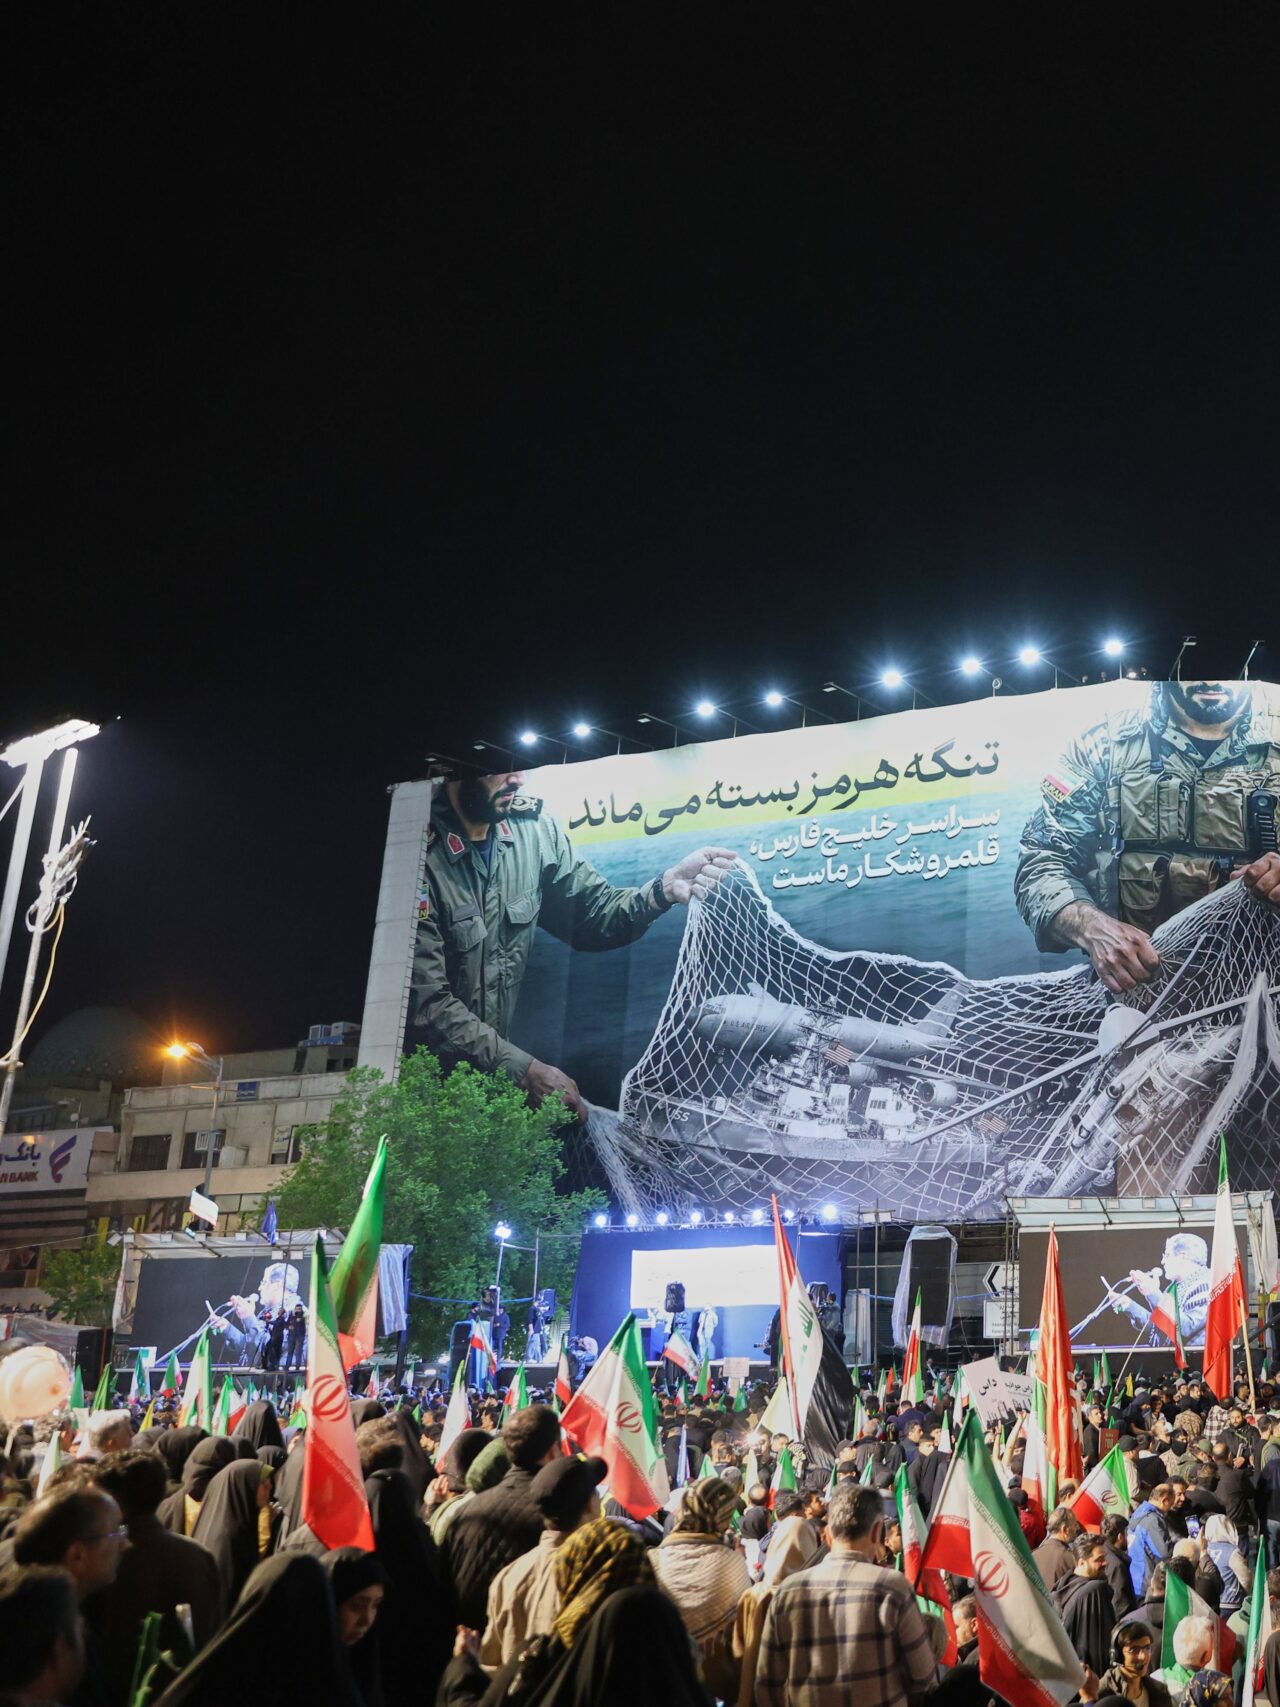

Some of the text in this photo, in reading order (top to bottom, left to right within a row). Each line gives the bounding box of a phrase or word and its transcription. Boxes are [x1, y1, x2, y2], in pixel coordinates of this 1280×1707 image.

[904, 737, 999, 782] تنگه
[706, 780, 799, 812] بسته
[796, 759, 899, 815] هرمز
[896, 805, 1000, 844] سراسر
[772, 832, 1000, 889] قلمرو شکار ماست
[4, 1142, 41, 1167] بانک
[9, 1170, 39, 1183] BANK
